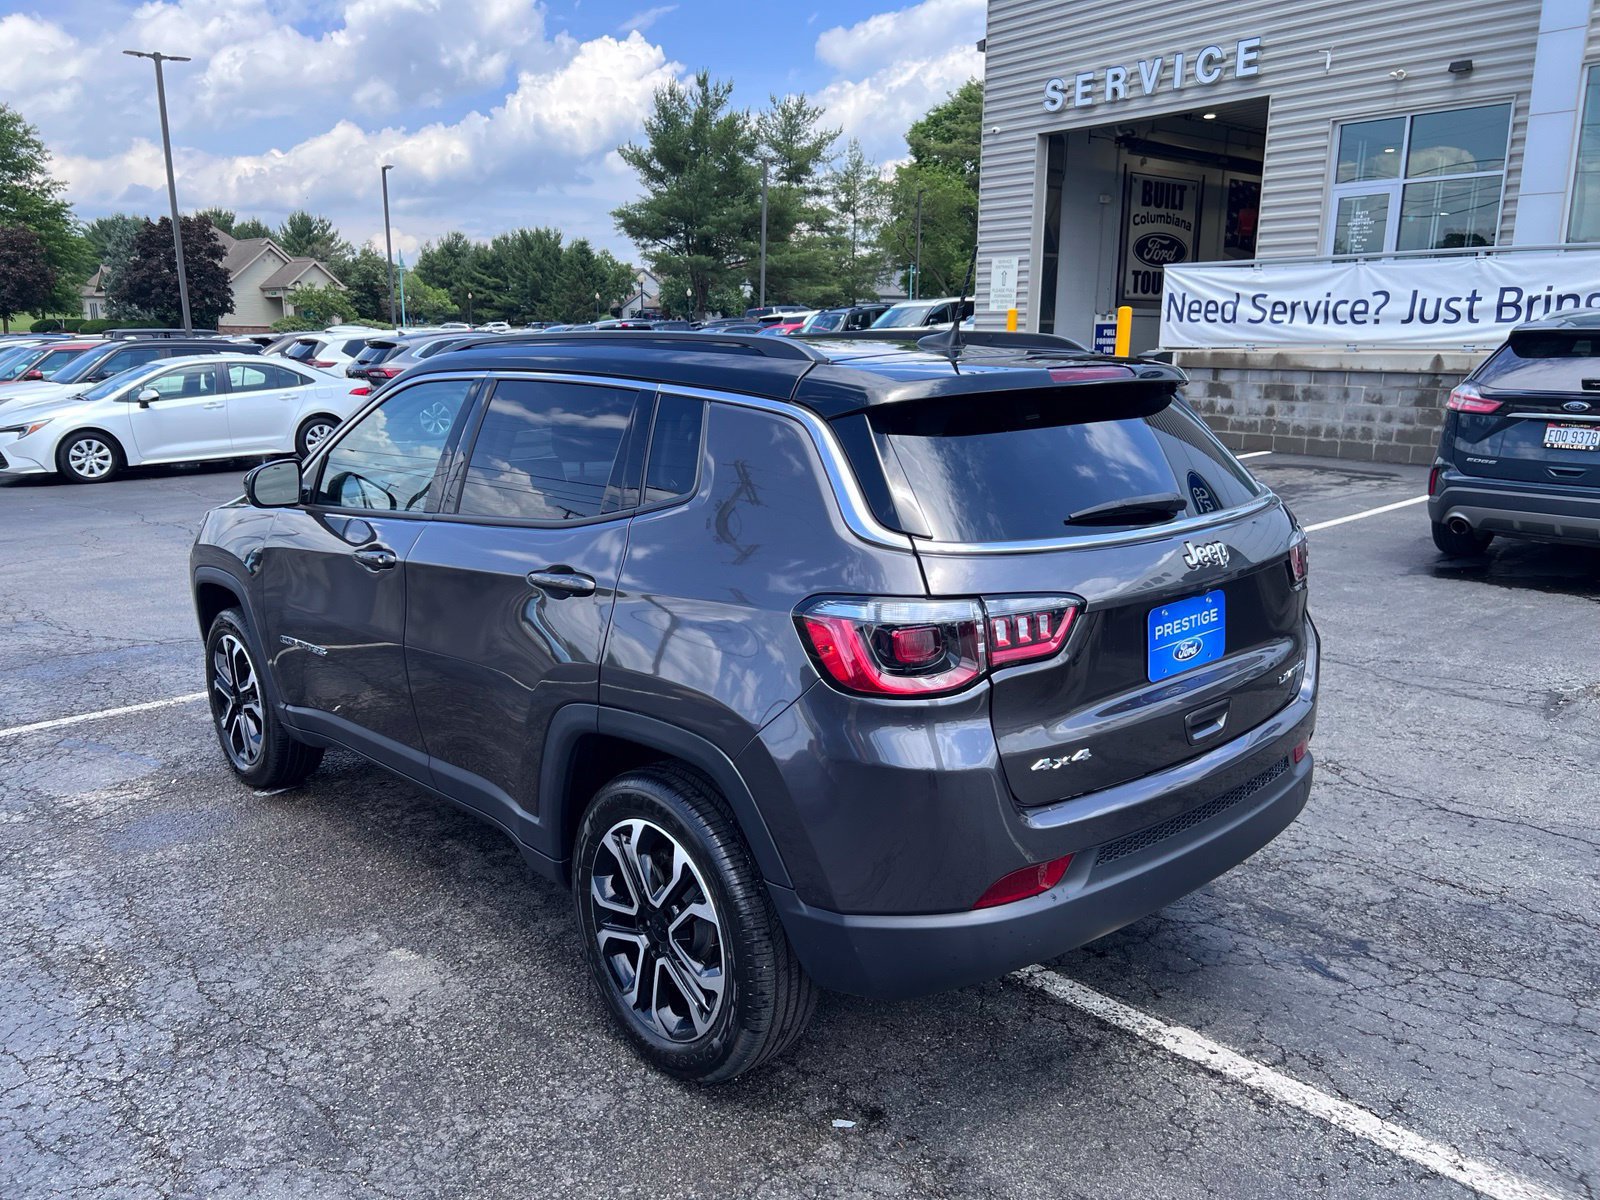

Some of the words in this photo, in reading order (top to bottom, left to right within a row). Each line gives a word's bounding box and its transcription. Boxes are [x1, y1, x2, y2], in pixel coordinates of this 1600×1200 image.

[1043, 36, 1262, 113] SERVICE
[1141, 181, 1187, 211] BUILT
[1132, 211, 1192, 232] Columbiana
[1143, 237, 1178, 261] Ford
[1132, 270, 1163, 295] TOU
[1166, 292, 1241, 324] Need
[1247, 290, 1391, 325] Service?
[1400, 289, 1483, 325] Just
[1494, 285, 1600, 323] Brin
[1103, 346, 1114, 354] FOR
[1571, 430, 1599, 445] 9378
[1466, 457, 1498, 465] EDGE
[1183, 540, 1230, 569] Jeep
[1155, 607, 1219, 640] PRESTIGE
[1030, 747, 1092, 771] 4x4
